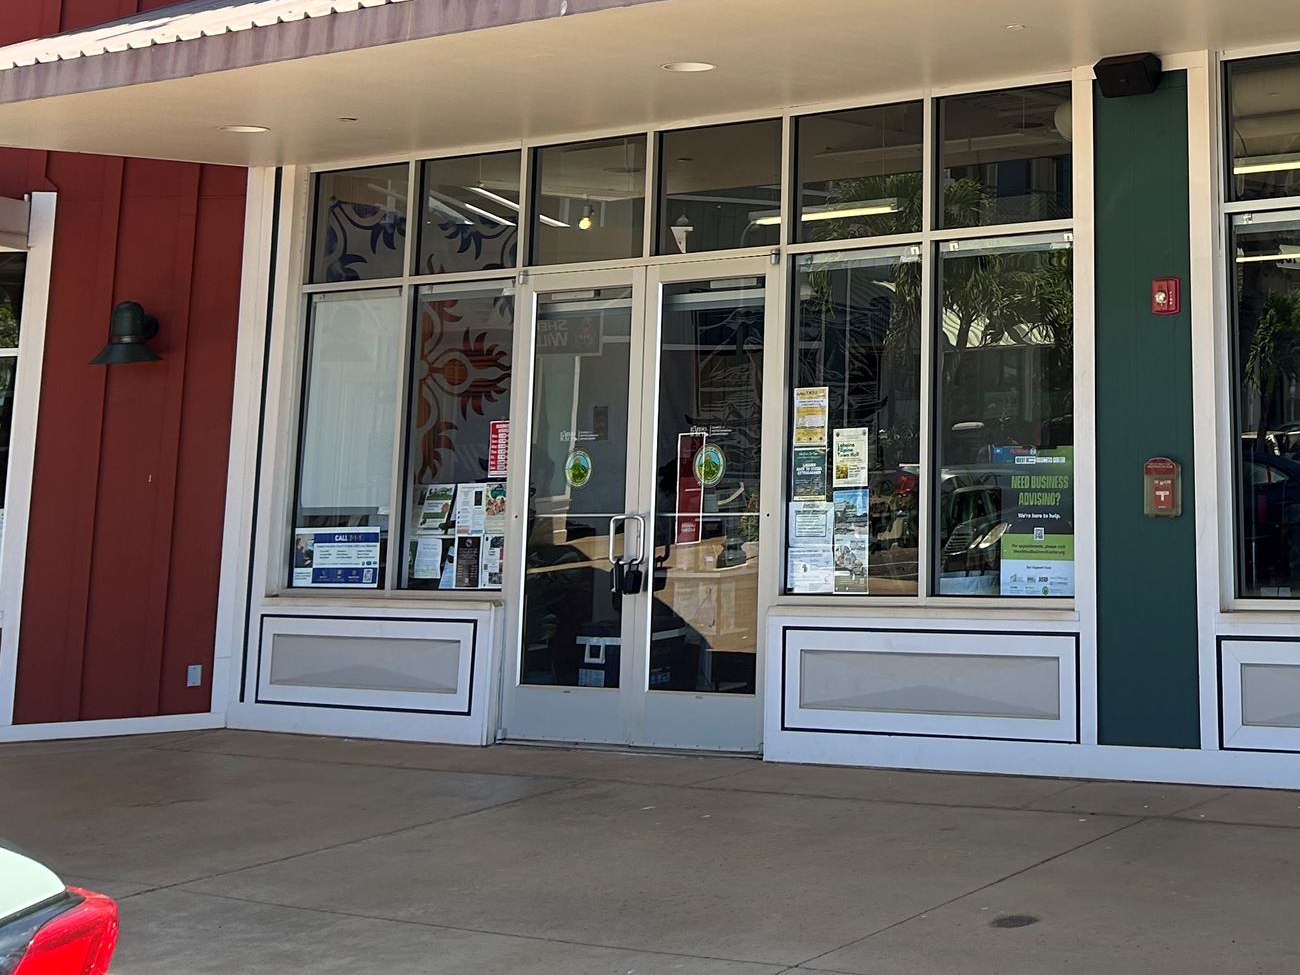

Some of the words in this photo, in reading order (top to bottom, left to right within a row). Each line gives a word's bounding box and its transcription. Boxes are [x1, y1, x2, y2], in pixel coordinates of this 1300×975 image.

[1011, 475, 1030, 489] NEED
[1031, 475, 1069, 489] BUSINESS
[1018, 492, 1061, 506] ADVISING?
[334, 534, 348, 542] CALL
